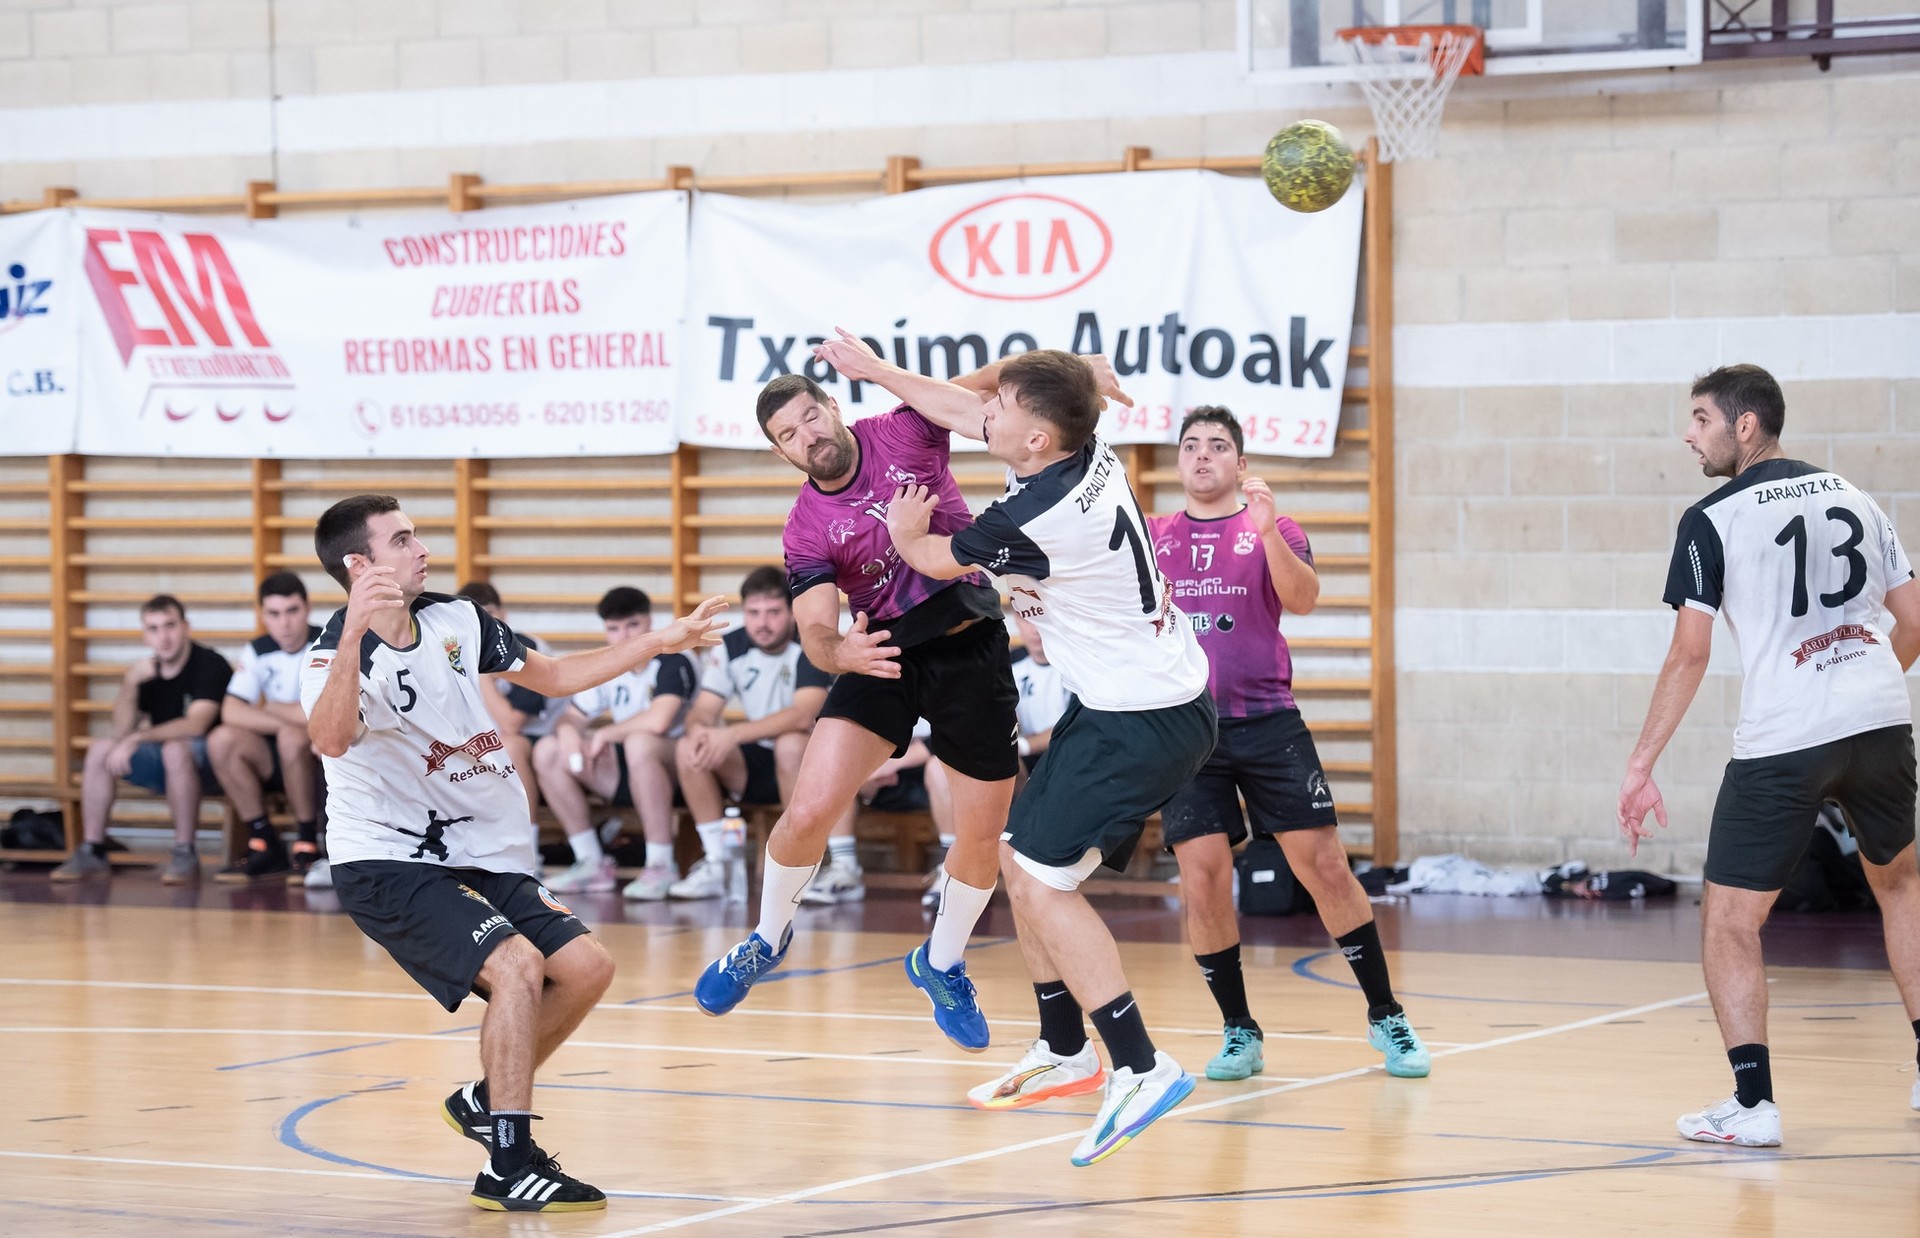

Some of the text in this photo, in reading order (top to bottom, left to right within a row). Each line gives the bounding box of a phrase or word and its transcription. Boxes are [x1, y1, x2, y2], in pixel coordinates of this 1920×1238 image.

[383, 221, 627, 267] CONSTRUCCIONES
[964, 218, 1081, 278] KIA
[85, 228, 271, 350] EM
[431, 278, 582, 319] CUBIERTAS
[344, 332, 672, 374] REFORMAS EN GENERAL
[1072, 312, 1336, 388] Autoak
[390, 403, 520, 429] 616343056
[543, 400, 671, 426] 620151260
[1116, 405, 1173, 432] 943
[1075, 461, 1110, 514] ZARAUTZ
[1755, 477, 1848, 504] ZARAUTZ K.E.
[1191, 544, 1215, 571] 13
[1775, 506, 1867, 617] 13
